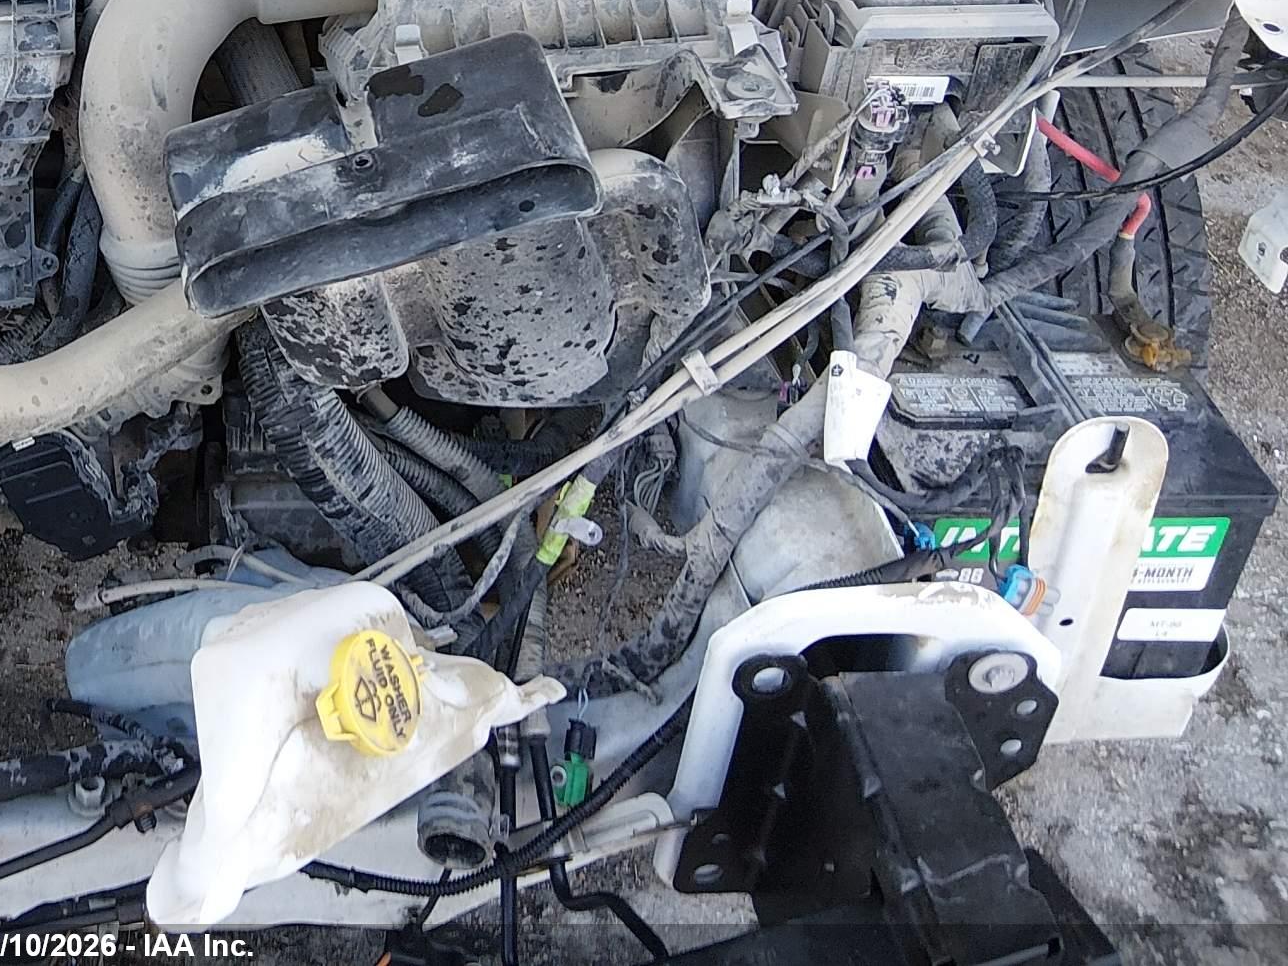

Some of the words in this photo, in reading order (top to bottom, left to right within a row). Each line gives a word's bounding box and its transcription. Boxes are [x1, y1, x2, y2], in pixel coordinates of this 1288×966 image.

[365, 637, 389, 690] FLUID
[384, 694, 407, 739] ONLY
[380, 644, 411, 723] WASHER
